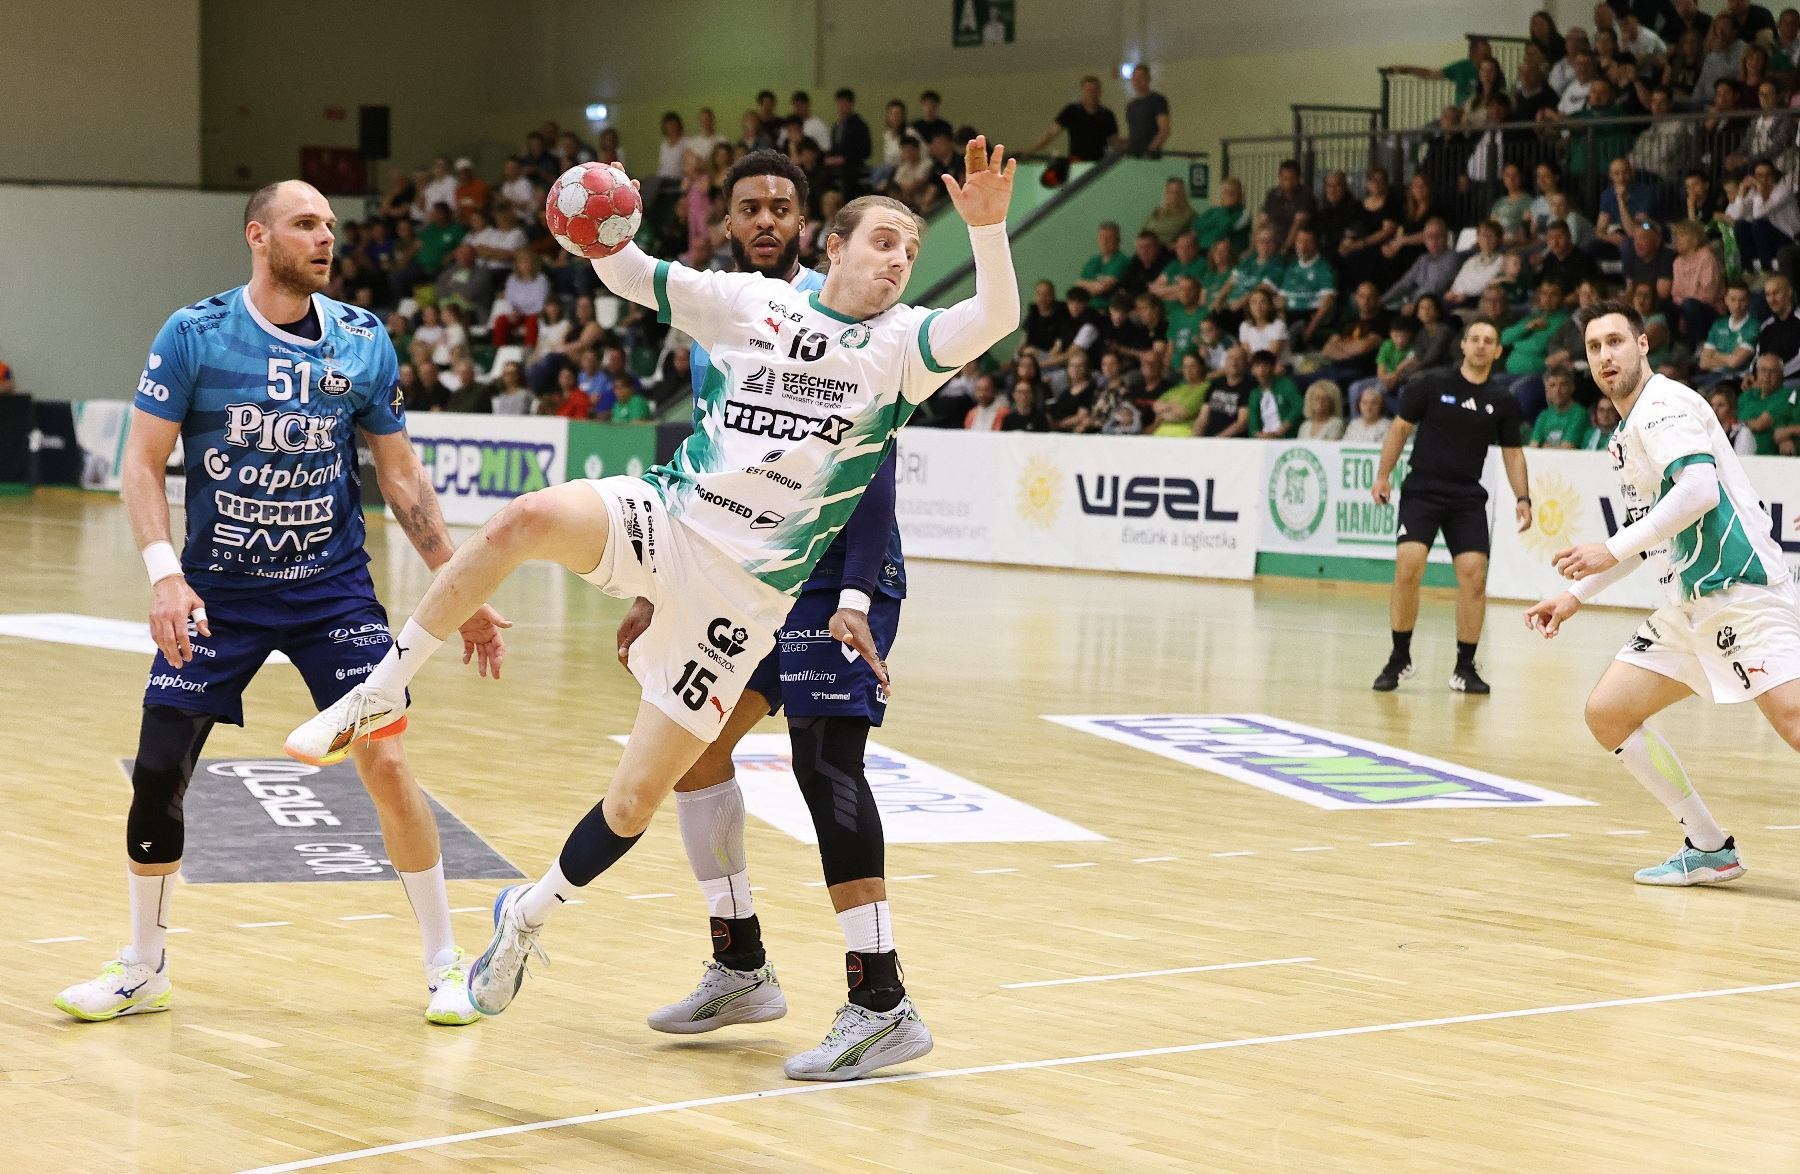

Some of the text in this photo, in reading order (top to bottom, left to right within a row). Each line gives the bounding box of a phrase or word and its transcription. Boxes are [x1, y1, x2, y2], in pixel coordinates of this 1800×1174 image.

[267, 357, 311, 404] 51
[782, 372, 858, 394] SZÉCHENYI
[783, 383, 844, 403] EGYETEM
[781, 394, 814, 405] UNIVERSITY
[224, 402, 337, 454] PICK
[238, 453, 343, 495] otpbank
[766, 471, 802, 491] GROUP
[1343, 458, 1373, 490] ETO
[695, 483, 753, 519] AGROFEED
[212, 522, 333, 551] SMP
[211, 548, 329, 564] SOLUTIONS
[353, 635, 388, 648] SZEGED
[780, 629, 832, 639] LEXUS
[697, 642, 735, 673] GYŐRSZOL
[672, 659, 718, 711] 15
[1732, 661, 1751, 690] 9
[821, 692, 851, 701] hummel
[242, 776, 343, 828] LEXUS
